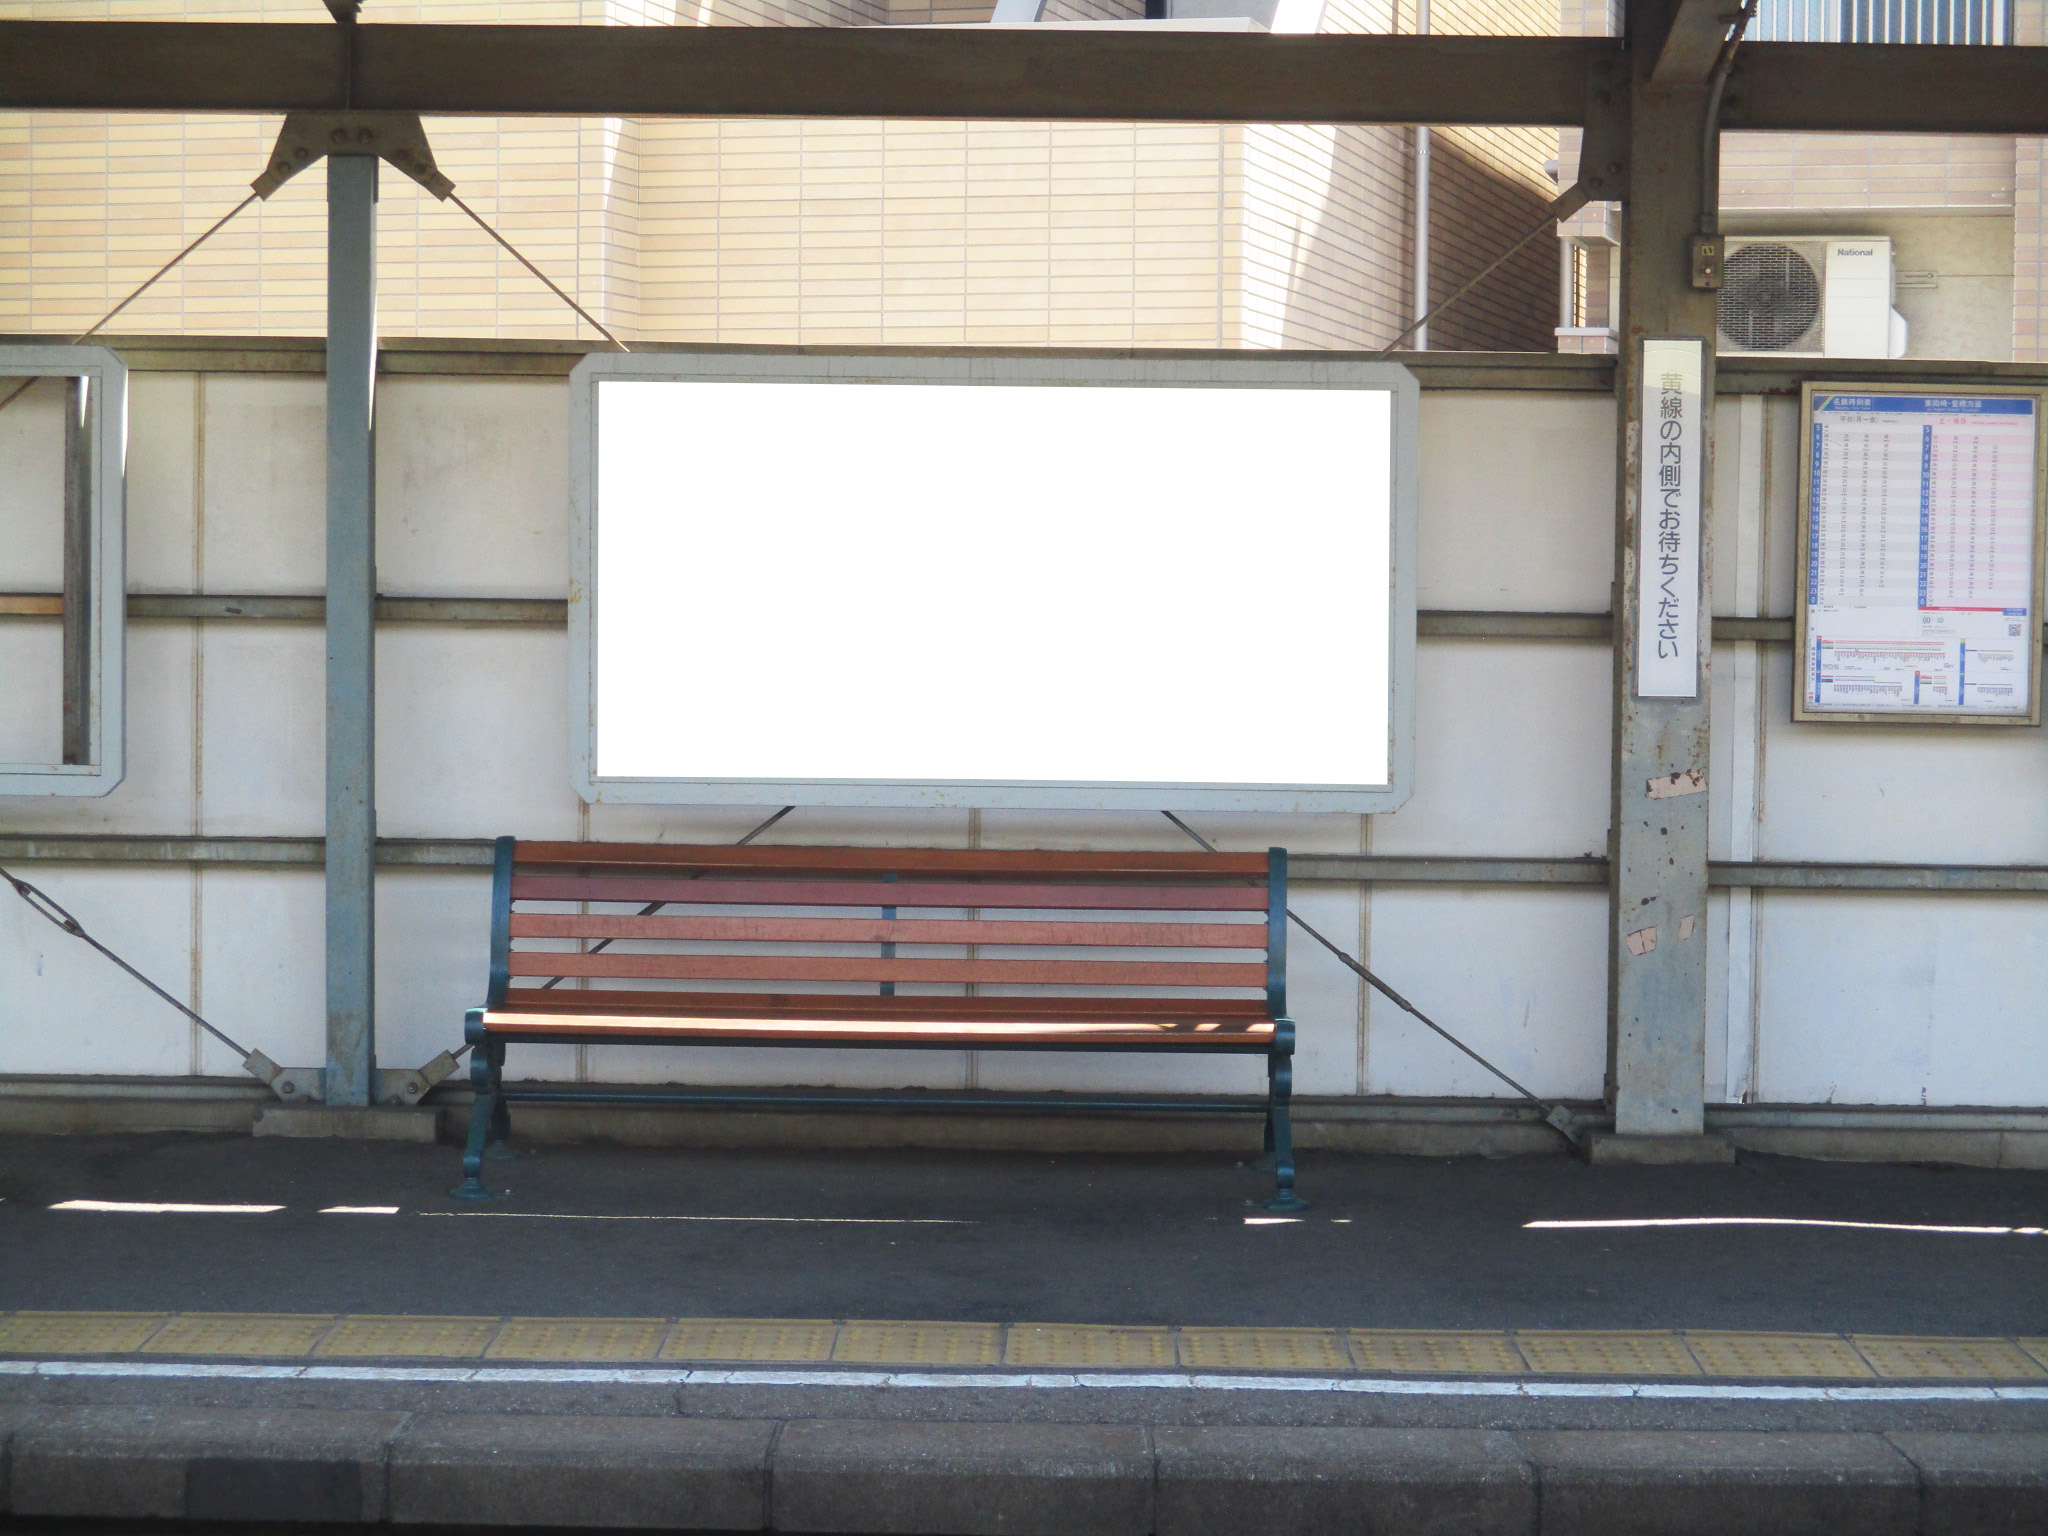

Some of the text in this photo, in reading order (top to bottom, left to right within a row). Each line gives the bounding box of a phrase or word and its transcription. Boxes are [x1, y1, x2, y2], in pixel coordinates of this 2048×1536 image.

[1837, 248, 1873, 256] National
[1657, 372, 1683, 660] 黄線の内側でお待ちください
